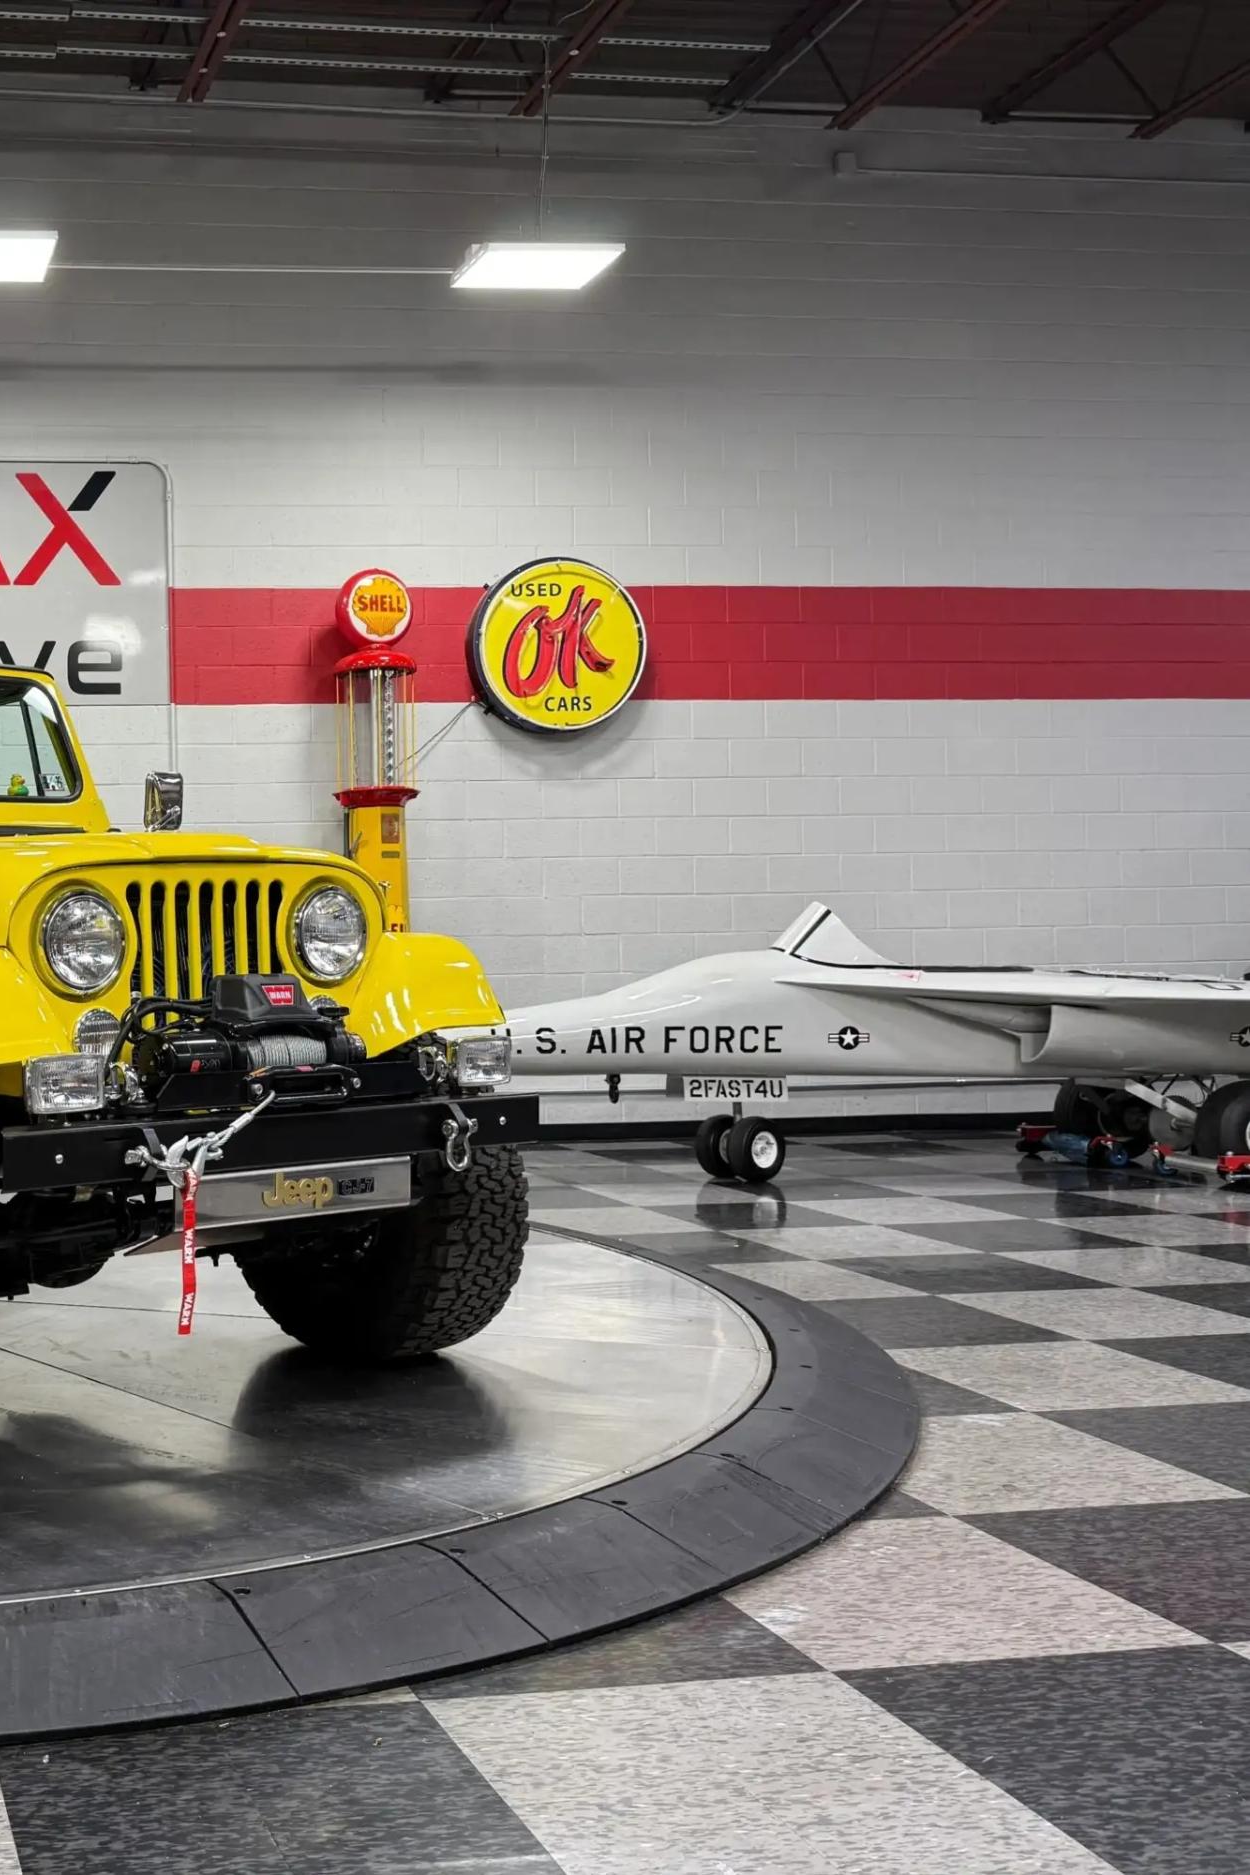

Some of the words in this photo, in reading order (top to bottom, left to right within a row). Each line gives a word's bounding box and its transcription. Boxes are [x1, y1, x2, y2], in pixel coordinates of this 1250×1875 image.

[511, 583, 562, 597] USED
[357, 594, 404, 613] SHELL
[502, 585, 615, 698] OK
[544, 696, 592, 711] CARS
[269, 991, 292, 999] WARN
[586, 1026, 645, 1054] AIR
[663, 1025, 783, 1054] FORCE
[689, 1079, 784, 1099] 2FAST4U
[261, 1171, 334, 1209] Jeep
[184, 1229, 195, 1264] WARN
[181, 1292, 194, 1326] WARN
